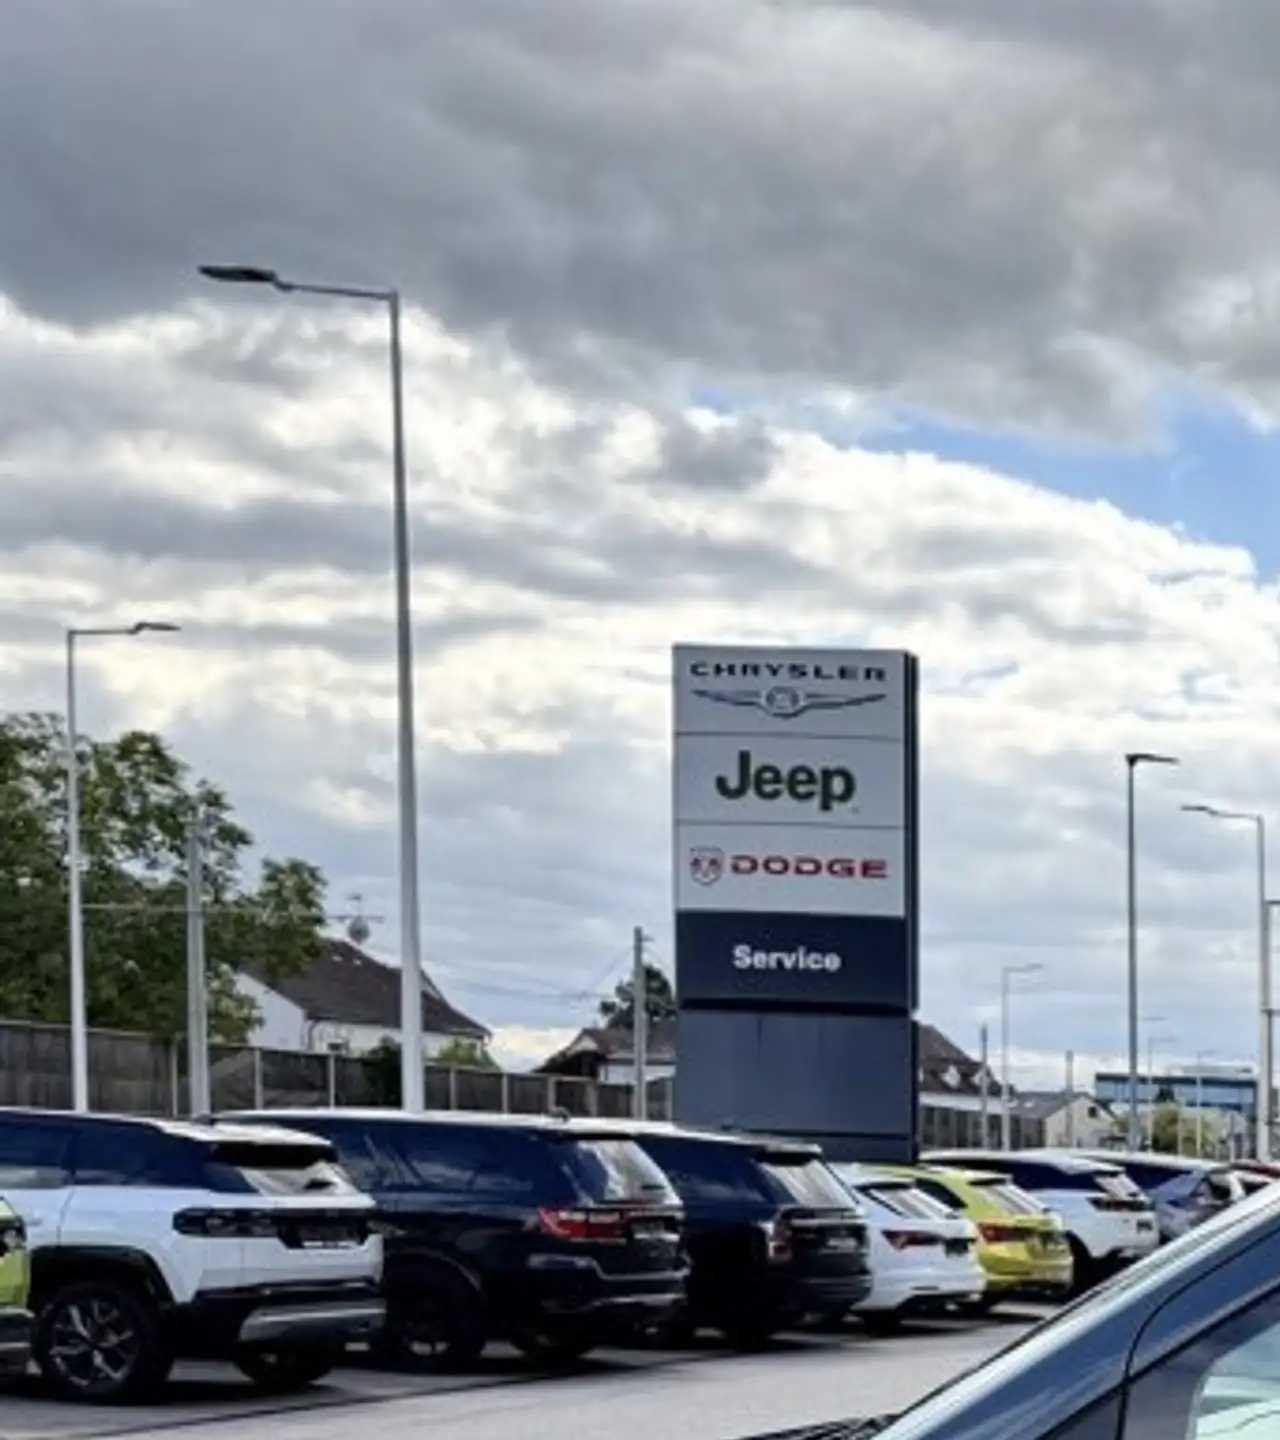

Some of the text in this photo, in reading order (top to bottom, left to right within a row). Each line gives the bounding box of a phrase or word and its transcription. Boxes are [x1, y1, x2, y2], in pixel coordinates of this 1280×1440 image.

[690, 660, 887, 682] CHRYSLER
[716, 750, 856, 811] Jeep
[731, 855, 888, 878] DODGE
[732, 945, 842, 971] Service
